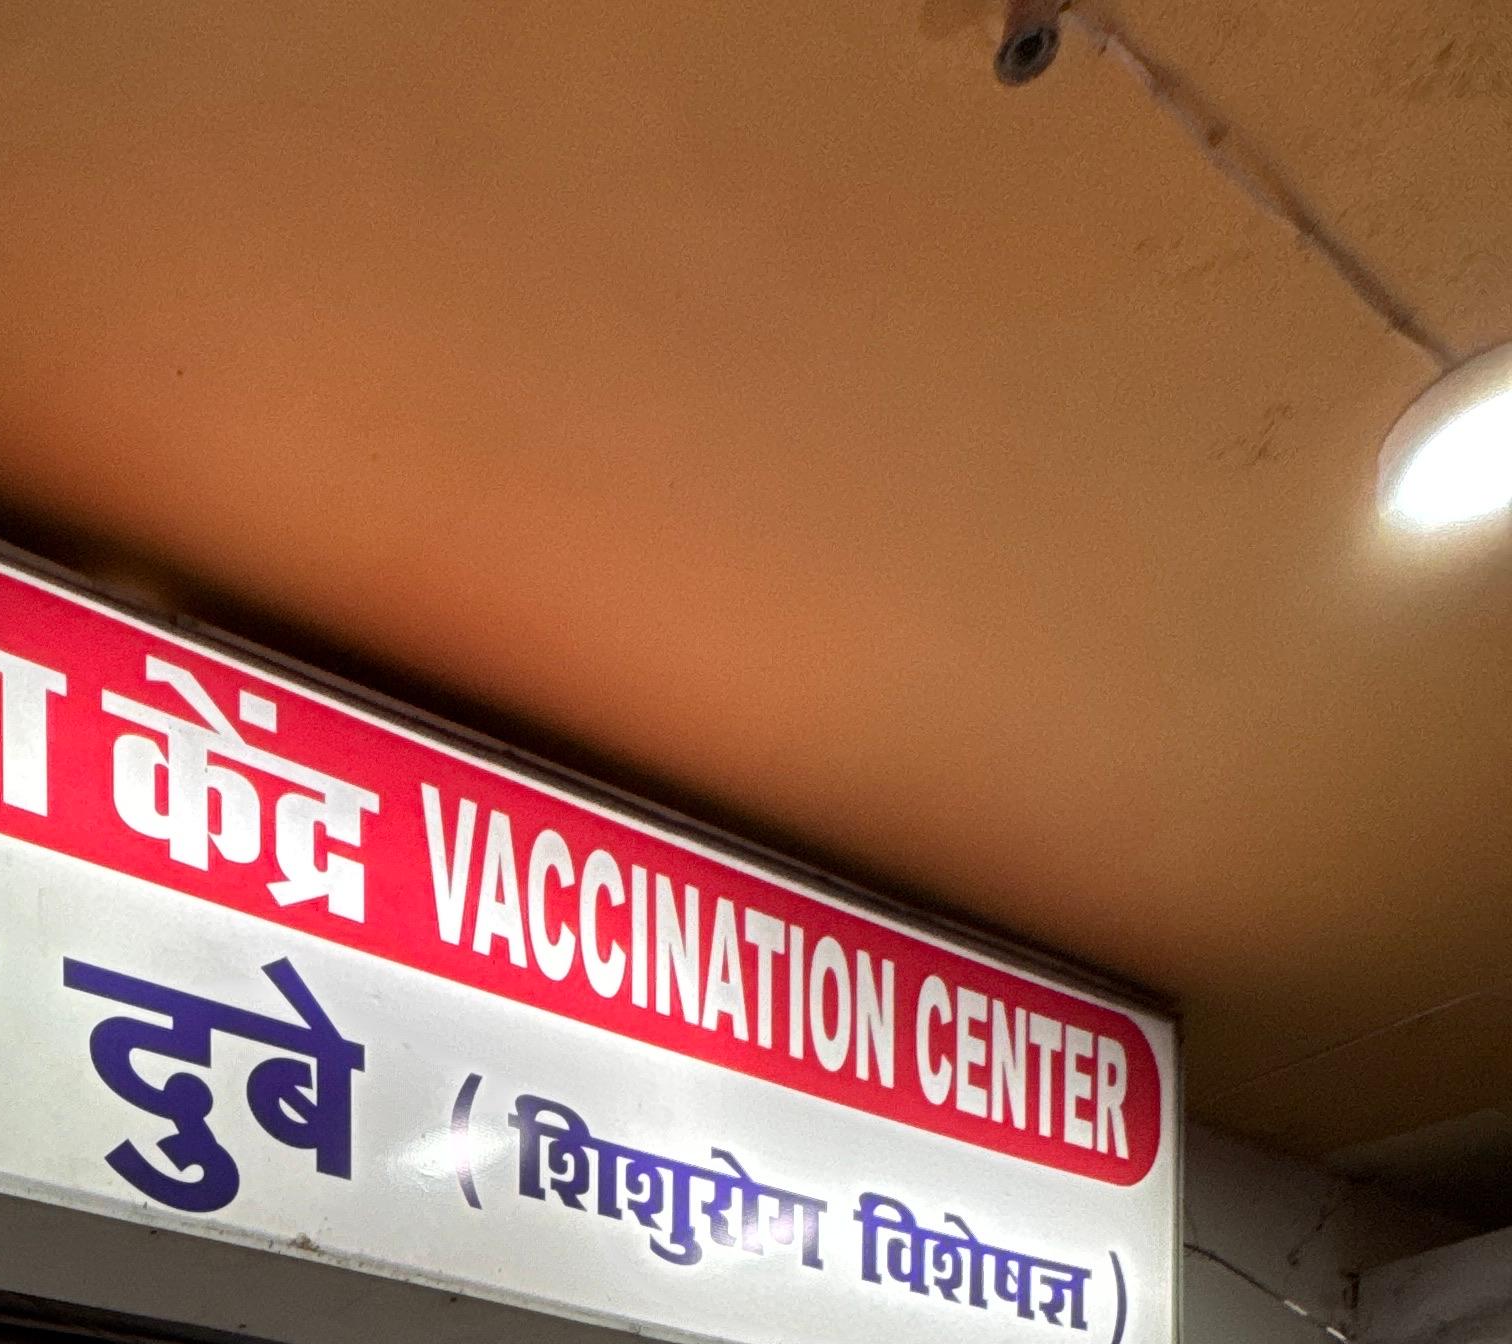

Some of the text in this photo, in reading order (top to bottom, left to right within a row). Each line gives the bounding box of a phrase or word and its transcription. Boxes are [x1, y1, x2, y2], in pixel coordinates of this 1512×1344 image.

[101, 654, 379, 923] केंद्र
[63, 956, 365, 1213] दुबे
[420, 783, 1131, 1162] VACCINATION CENTER
